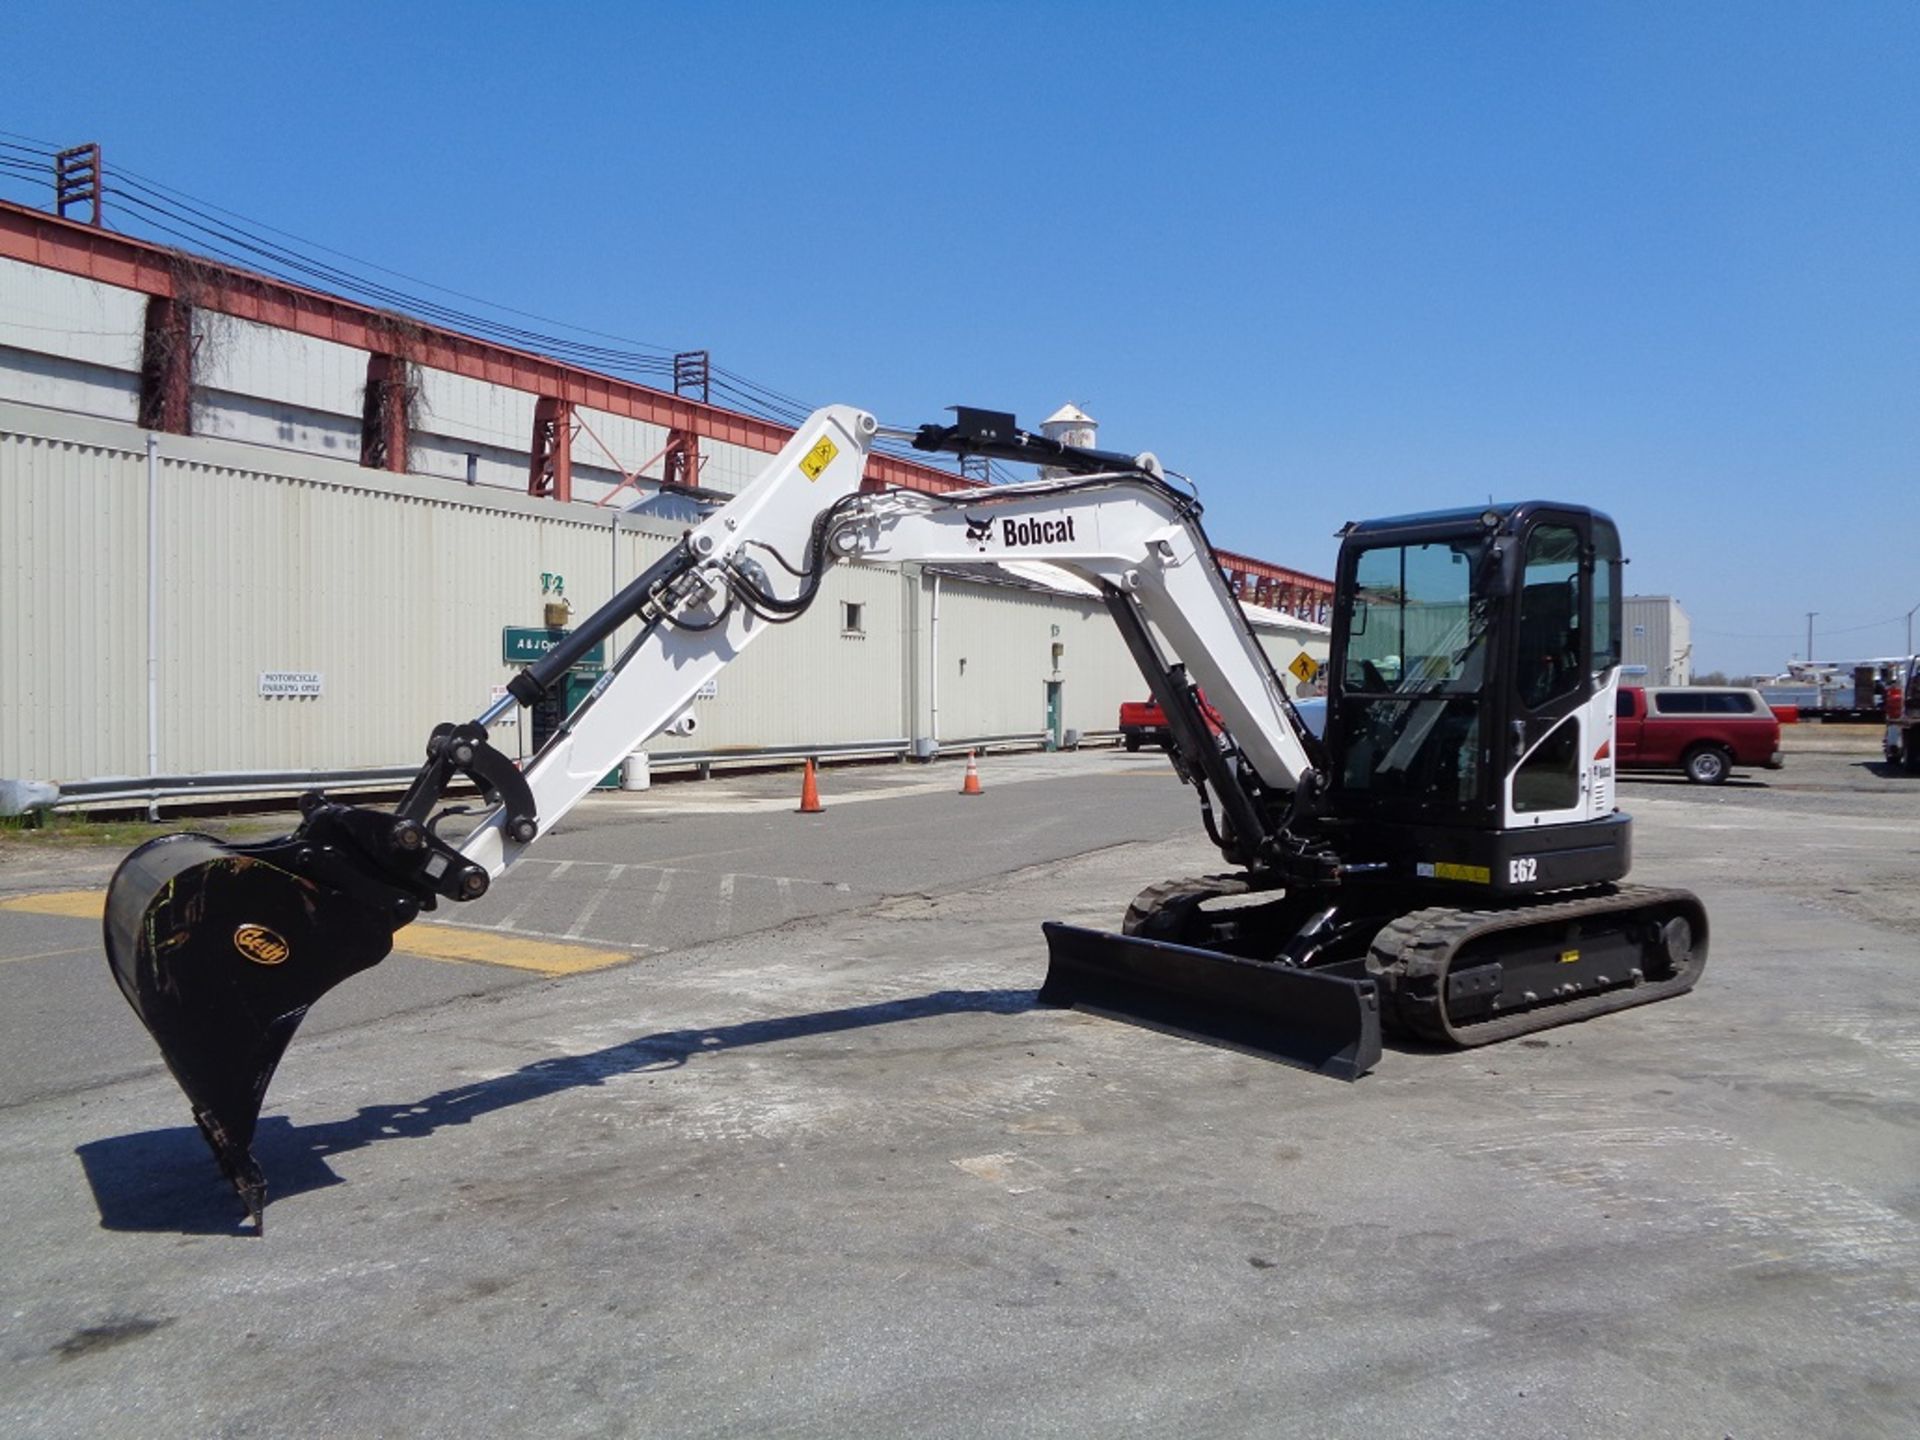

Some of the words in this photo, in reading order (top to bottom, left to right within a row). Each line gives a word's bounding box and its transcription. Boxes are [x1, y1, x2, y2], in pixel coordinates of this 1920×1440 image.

[1003, 516, 1075, 547] Bobcat
[541, 573, 564, 589] T2
[517, 639, 524, 648] A
[534, 640, 540, 649] J
[265, 674, 319, 682] MOTORCYCLE
[262, 684, 299, 692] PARKING
[301, 684, 320, 692] ONLY
[1509, 858, 1537, 883] E62
